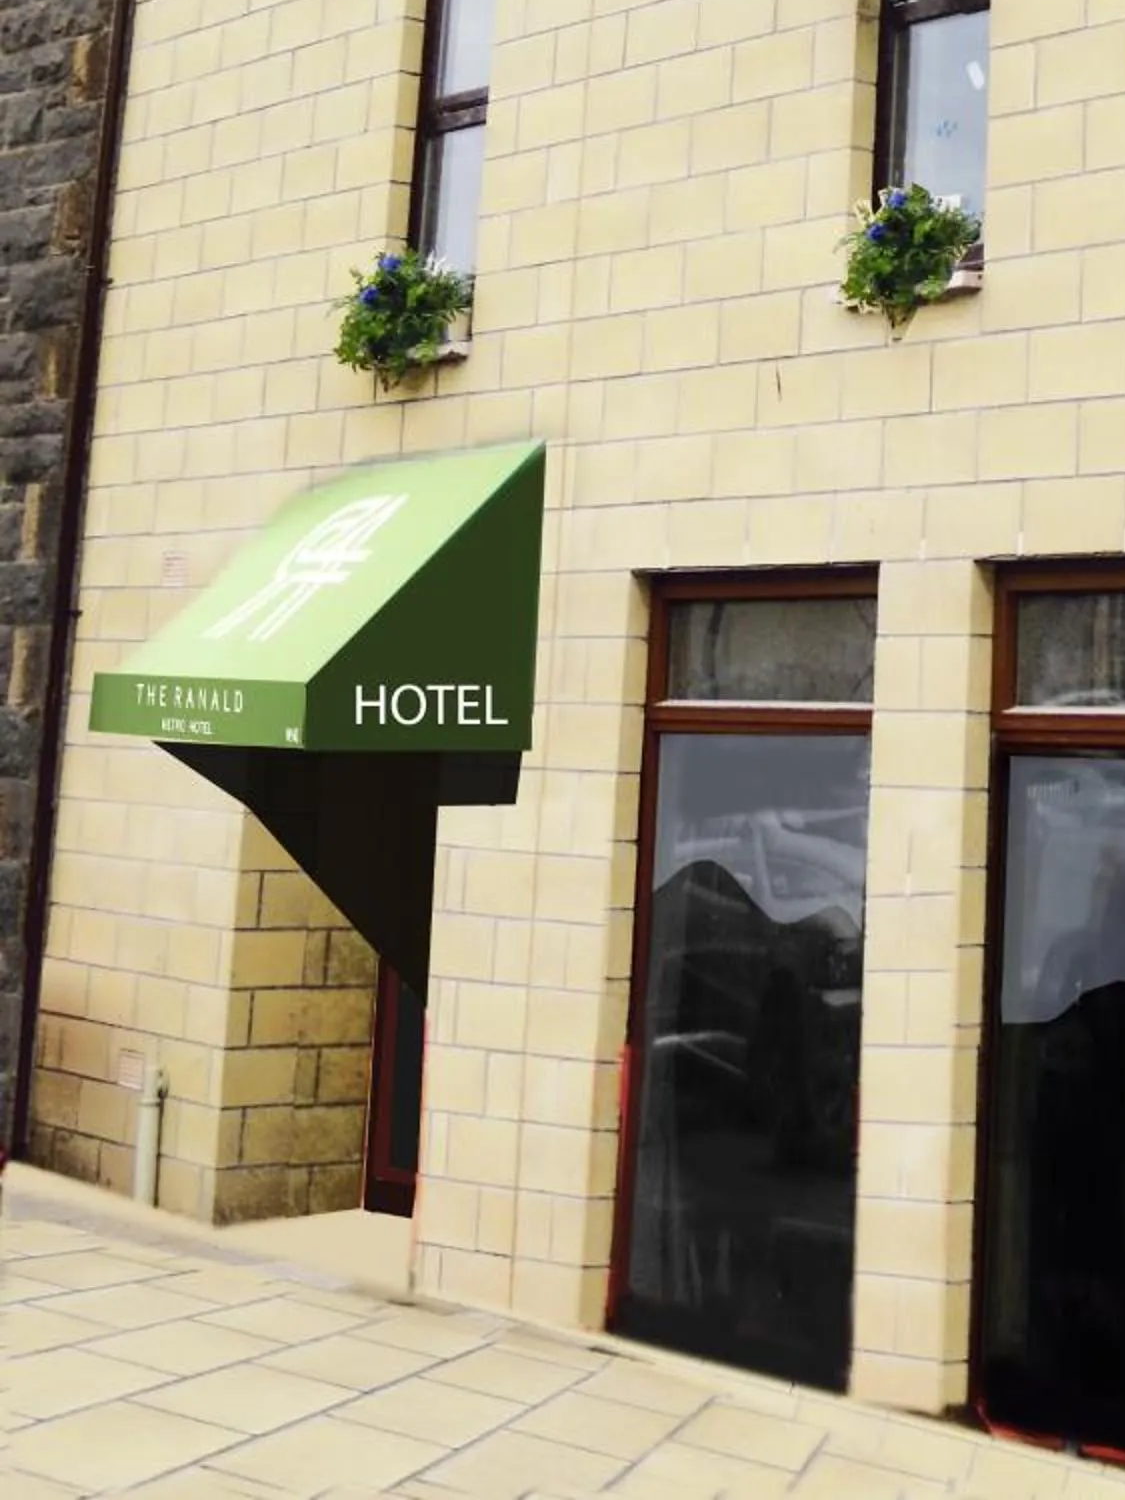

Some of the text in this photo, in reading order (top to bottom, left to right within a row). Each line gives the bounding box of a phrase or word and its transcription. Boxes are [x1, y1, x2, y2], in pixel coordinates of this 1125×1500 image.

[136, 683, 244, 713] THE RANALD
[355, 684, 509, 725] HOTEL
